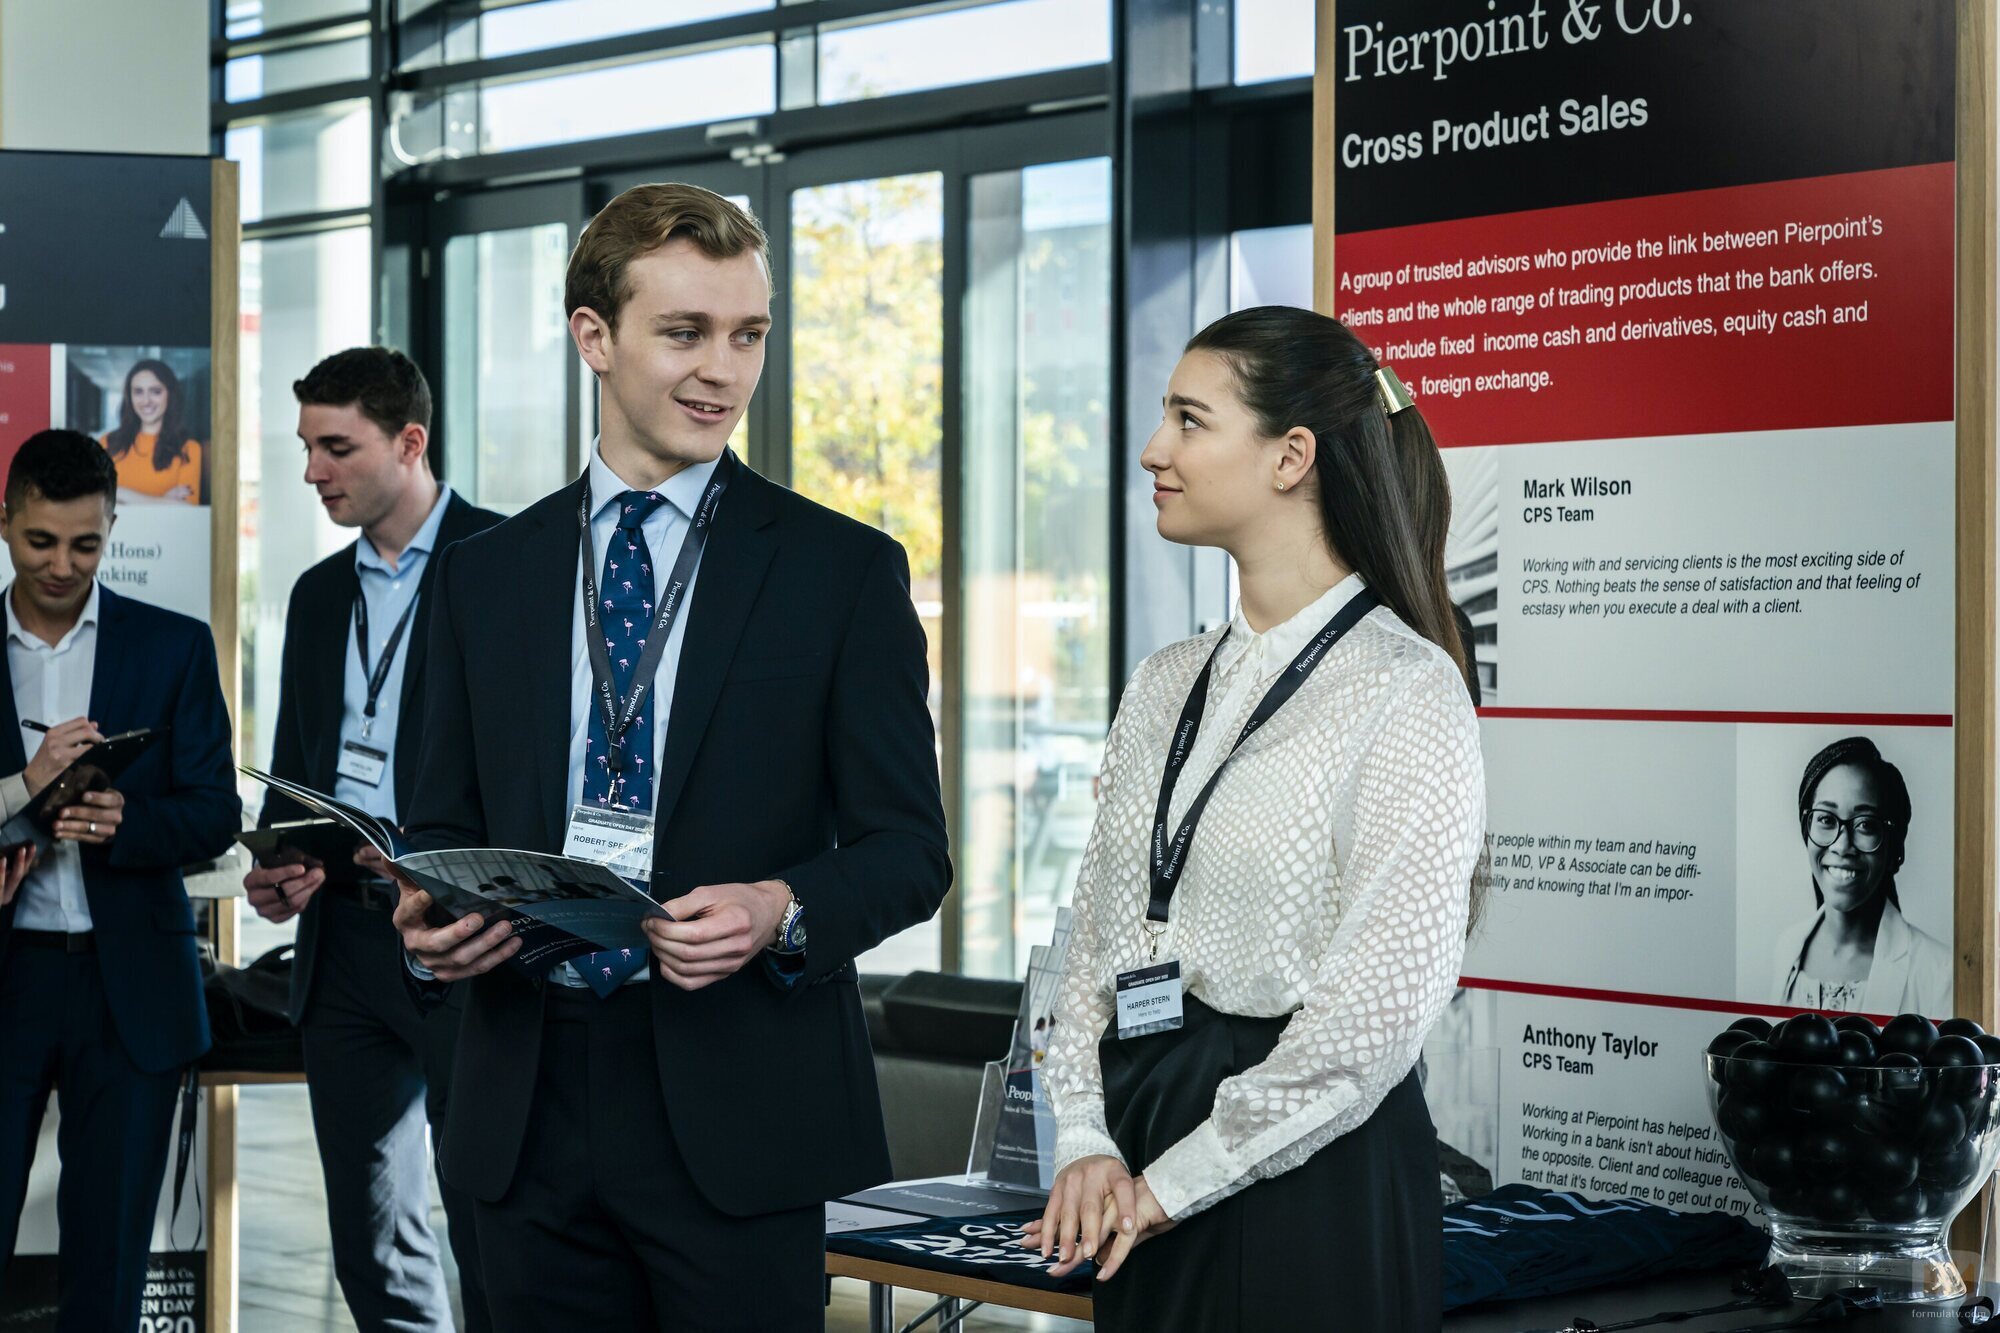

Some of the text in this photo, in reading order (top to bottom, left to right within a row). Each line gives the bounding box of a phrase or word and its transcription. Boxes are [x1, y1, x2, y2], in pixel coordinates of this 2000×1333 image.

[1343, 0, 1693, 82] Pierpoint & Co.
[1342, 95, 1649, 168] Cross Product Sales
[1340, 272, 1351, 291] A
[1353, 270, 1393, 294] group
[1396, 265, 1410, 284] of
[1414, 259, 1463, 281] trusted
[1467, 255, 1530, 277] advisors
[1534, 249, 1567, 270] who
[1571, 241, 1631, 270] provide
[1637, 239, 1663, 259] the
[1668, 234, 1697, 256] link
[1703, 229, 1778, 253] between
[1340, 260, 1878, 328] clients and the whole range of trading products that the bank offers.
[1386, 338, 1436, 361] include
[1440, 333, 1475, 356] fixed
[1483, 331, 1539, 352] income
[1542, 325, 1581, 347] cash
[1586, 322, 1616, 343] and
[1621, 315, 1718, 342] derivatives,
[1723, 309, 1778, 336] equity
[1782, 304, 1827, 328] cash
[1832, 300, 1868, 323] and
[1421, 374, 1471, 398] foreign
[1475, 370, 1554, 393] exchange.
[702, 483, 721, 514] Pierpoint
[1524, 477, 1632, 499] Mark Wilson
[1523, 506, 1594, 523] CPS Team
[100, 565, 148, 587] nking
[1523, 549, 1905, 575] Working with and servicing clients is the most exciting side of
[665, 581, 683, 611] Pierpoint
[1522, 572, 1922, 596] CPS. Nothing beats the sense of satisfaction and that feeling of
[1522, 598, 1803, 618] ecstasy when you execute a deal with a client.
[1295, 642, 1322, 673] Pierpoint
[1324, 629, 1338, 640] Co.
[626, 684, 645, 716] Pierpoint
[573, 834, 648, 855] ROBERT SPEING
[1163, 844, 1182, 880] Pierpoint
[1181, 824, 1192, 836] Co.
[1497, 833, 1535, 849] people
[1538, 835, 1571, 850] within
[1574, 838, 1593, 854] my
[1595, 838, 1625, 852] team
[1629, 840, 1652, 854] and
[1655, 841, 1697, 860] having
[1494, 856, 1508, 867] an
[1511, 854, 1533, 870] MD,
[1538, 856, 1555, 870] VP
[1557, 857, 1566, 871] &
[1569, 858, 1627, 875] Associate
[1630, 863, 1652, 876] can
[1655, 861, 1672, 877] be
[1675, 863, 1702, 879] diffi-
[1513, 876, 1534, 890] and
[1537, 877, 1585, 897] knowing
[1588, 880, 1611, 896] that
[1614, 881, 1632, 897] I'm
[1635, 885, 1651, 898] an
[1654, 885, 1694, 902] impor-
[1127, 995, 1171, 1011] HARPER STERN
[1523, 1024, 1659, 1059] Anthony Taylor
[1523, 1052, 1594, 1076] CPS Team
[1522, 1102, 1568, 1125] Working
[1571, 1108, 1583, 1124] at
[1586, 1110, 1639, 1132] Pierpoint
[1642, 1119, 1664, 1135] has
[1668, 1122, 1710, 1142] helped
[1522, 1124, 1732, 1169] Working in a bank isn't about hiding
[1522, 1145, 1539, 1161] the
[1542, 1149, 1595, 1169] opposite.
[1598, 1156, 1633, 1174] Client
[1636, 1161, 1659, 1178] and
[1662, 1165, 1722, 1188] colleague
[1521, 1167, 1543, 1184] tant
[1546, 1171, 1567, 1187] that
[1571, 1174, 1587, 1190] it's
[1590, 1176, 1627, 1196] forced
[1630, 1186, 1649, 1199] me
[1653, 1187, 1665, 1201] to
[1668, 1190, 1688, 1206] get
[1691, 1193, 1711, 1209] out
[1715, 1195, 1728, 1211] of
[1731, 1201, 1750, 1216] my
[143, 1282, 195, 1297] DUATE
[141, 1299, 195, 1315] EN DAY
[138, 1316, 196, 1333] 020
